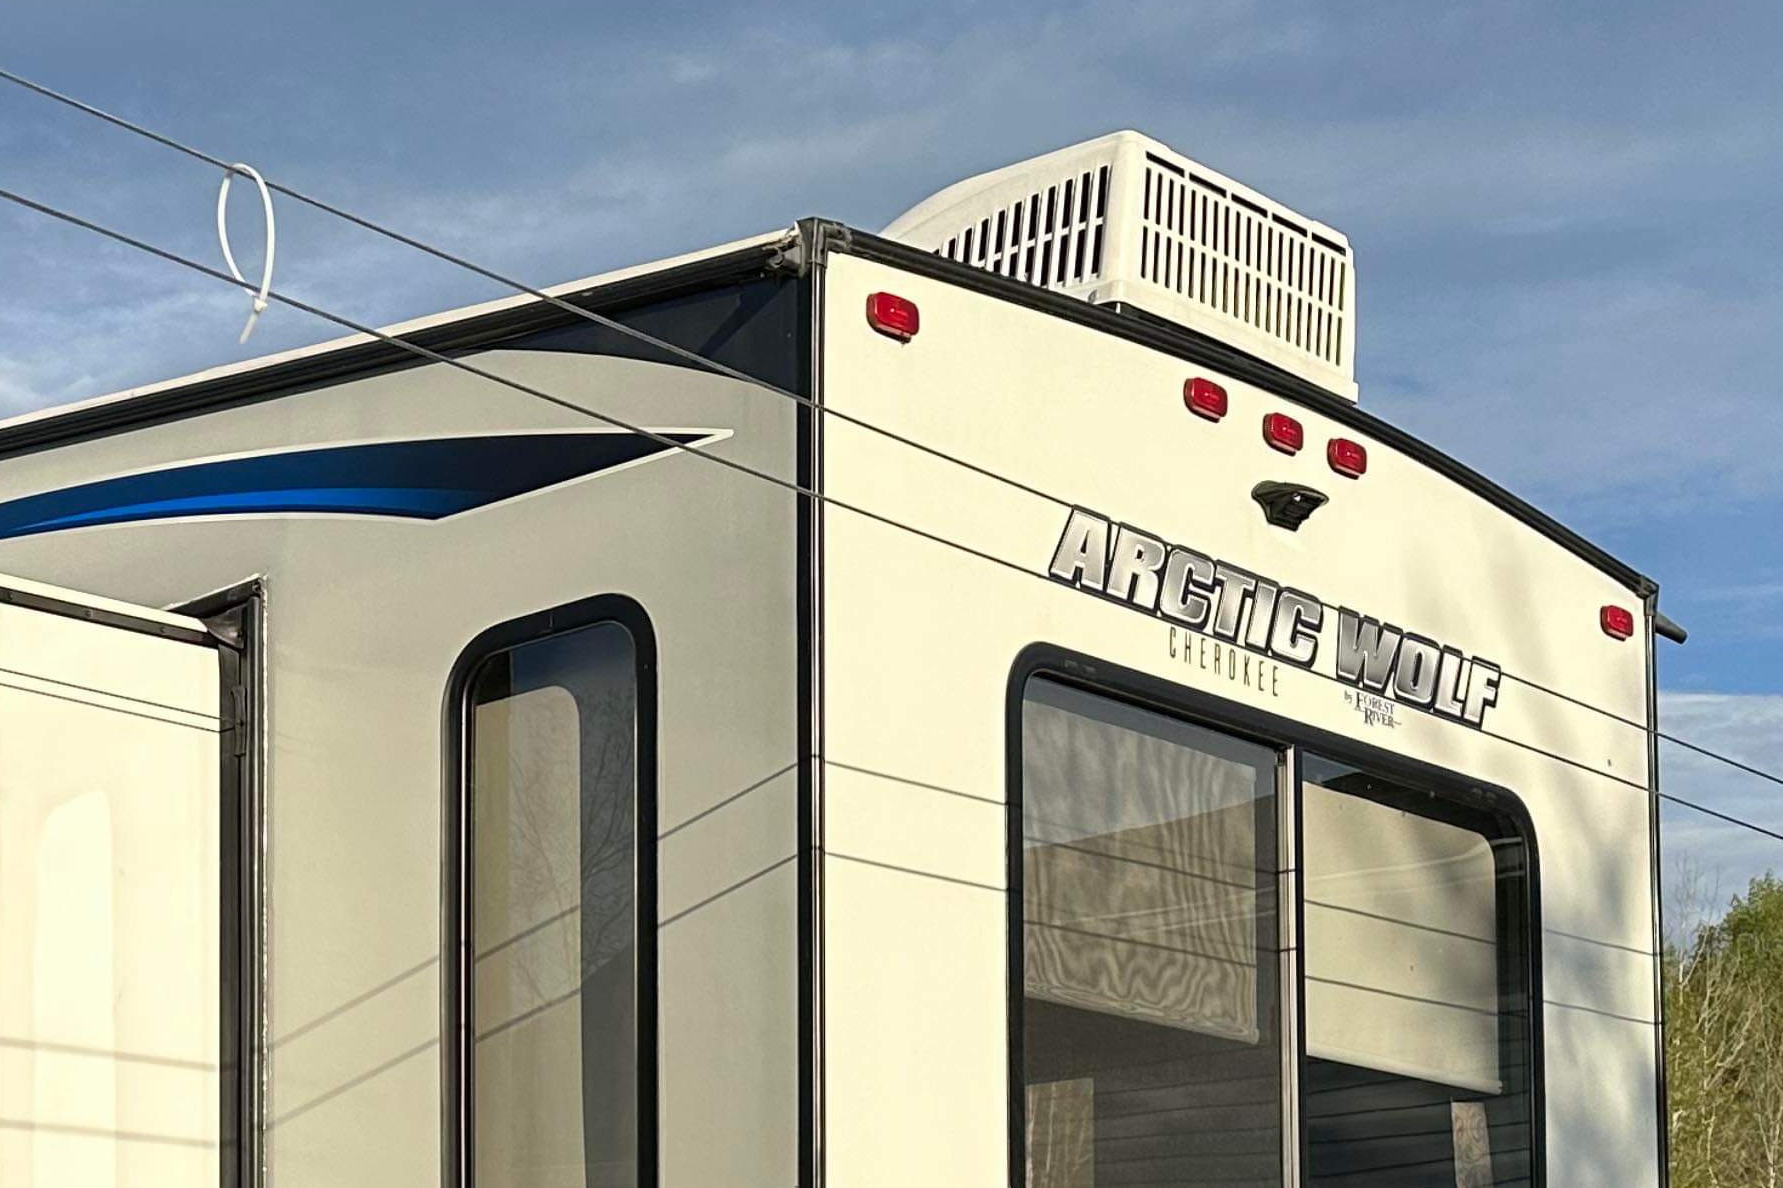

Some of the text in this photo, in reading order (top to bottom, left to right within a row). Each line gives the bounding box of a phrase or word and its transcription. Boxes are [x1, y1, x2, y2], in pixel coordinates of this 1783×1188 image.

[1048, 504, 1501, 730] ARCTIC WOLF
[1168, 626, 1280, 698] CHEROKEE
